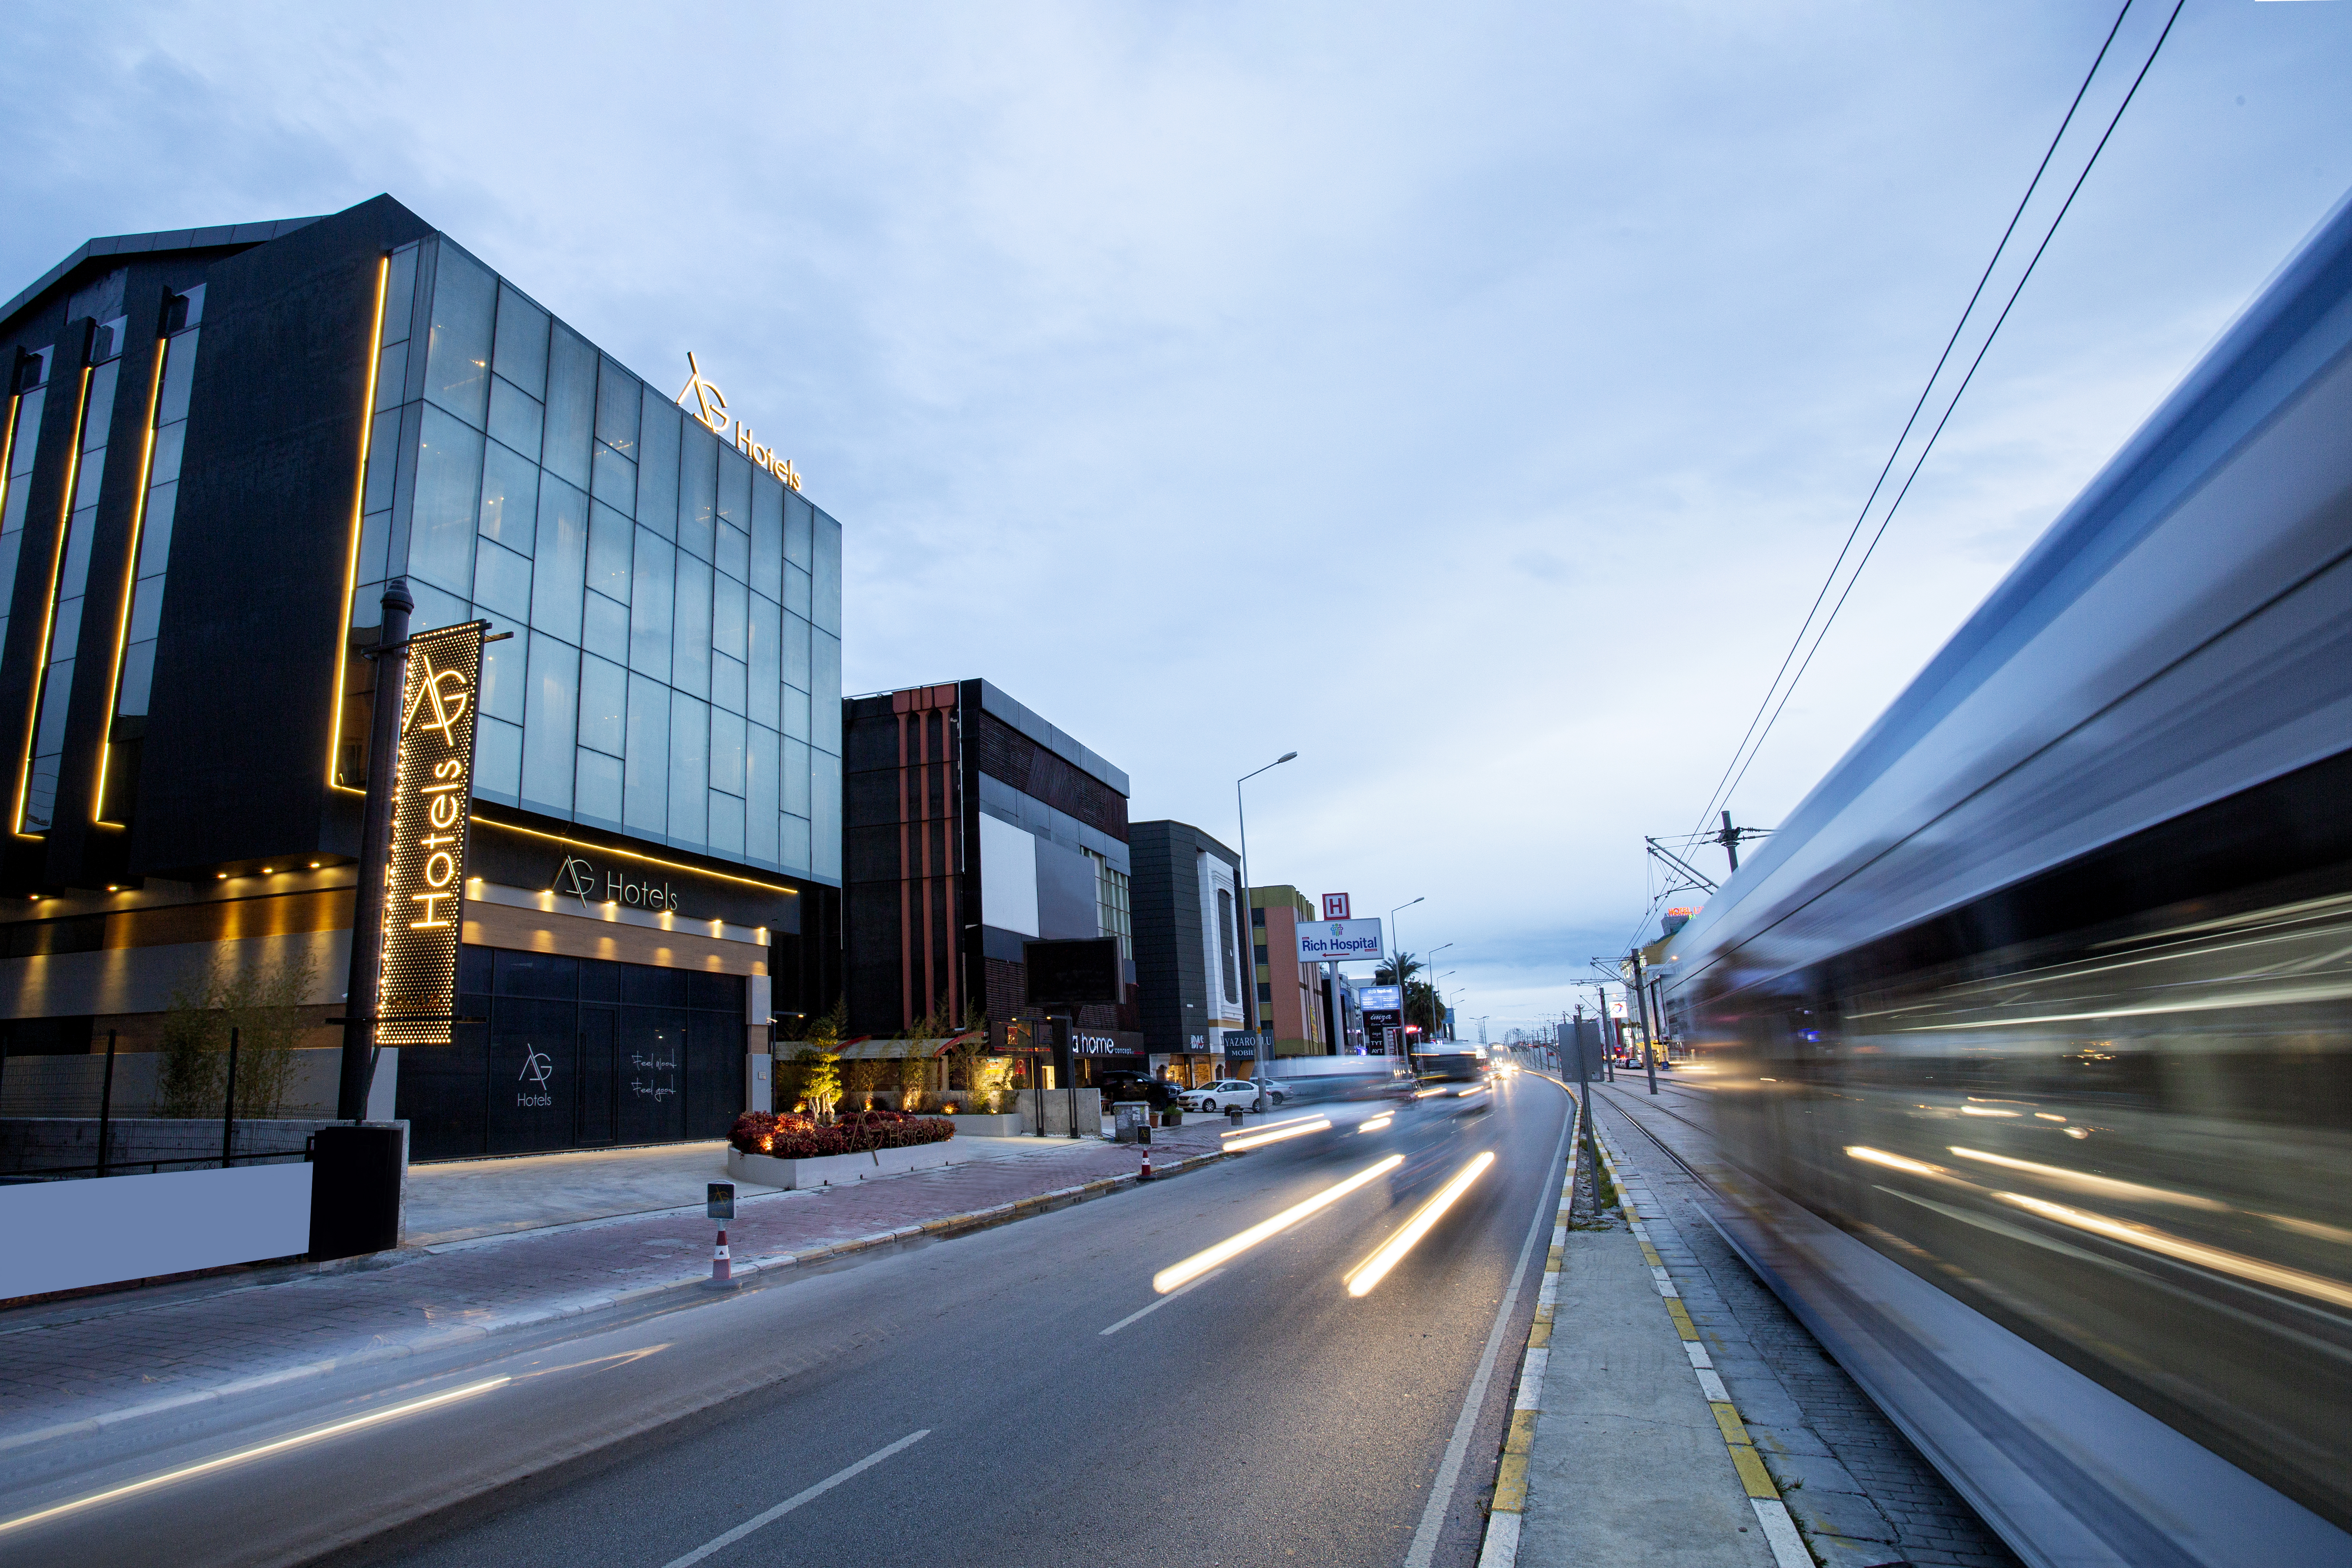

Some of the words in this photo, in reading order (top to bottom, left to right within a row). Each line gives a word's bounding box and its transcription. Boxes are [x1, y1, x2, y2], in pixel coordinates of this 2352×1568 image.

[736, 421, 801, 491] Hotels
[410, 759, 461, 929] Hotels
[607, 871, 677, 911] Hotels
[1329, 898, 1343, 914] H
[1668, 907, 1693, 916] HOTEL
[1302, 940, 1327, 951] Rich
[1330, 937, 1377, 951] Hospital
[1370, 1014, 1392, 1022] imza
[1082, 1033, 1114, 1054] home
[1225, 1036, 1271, 1047] YAZAROLU
[632, 1050, 653, 1071] Feel
[631, 1077, 653, 1098] Feel
[655, 1074, 676, 1102] good
[517, 1093, 551, 1107] Hotels
